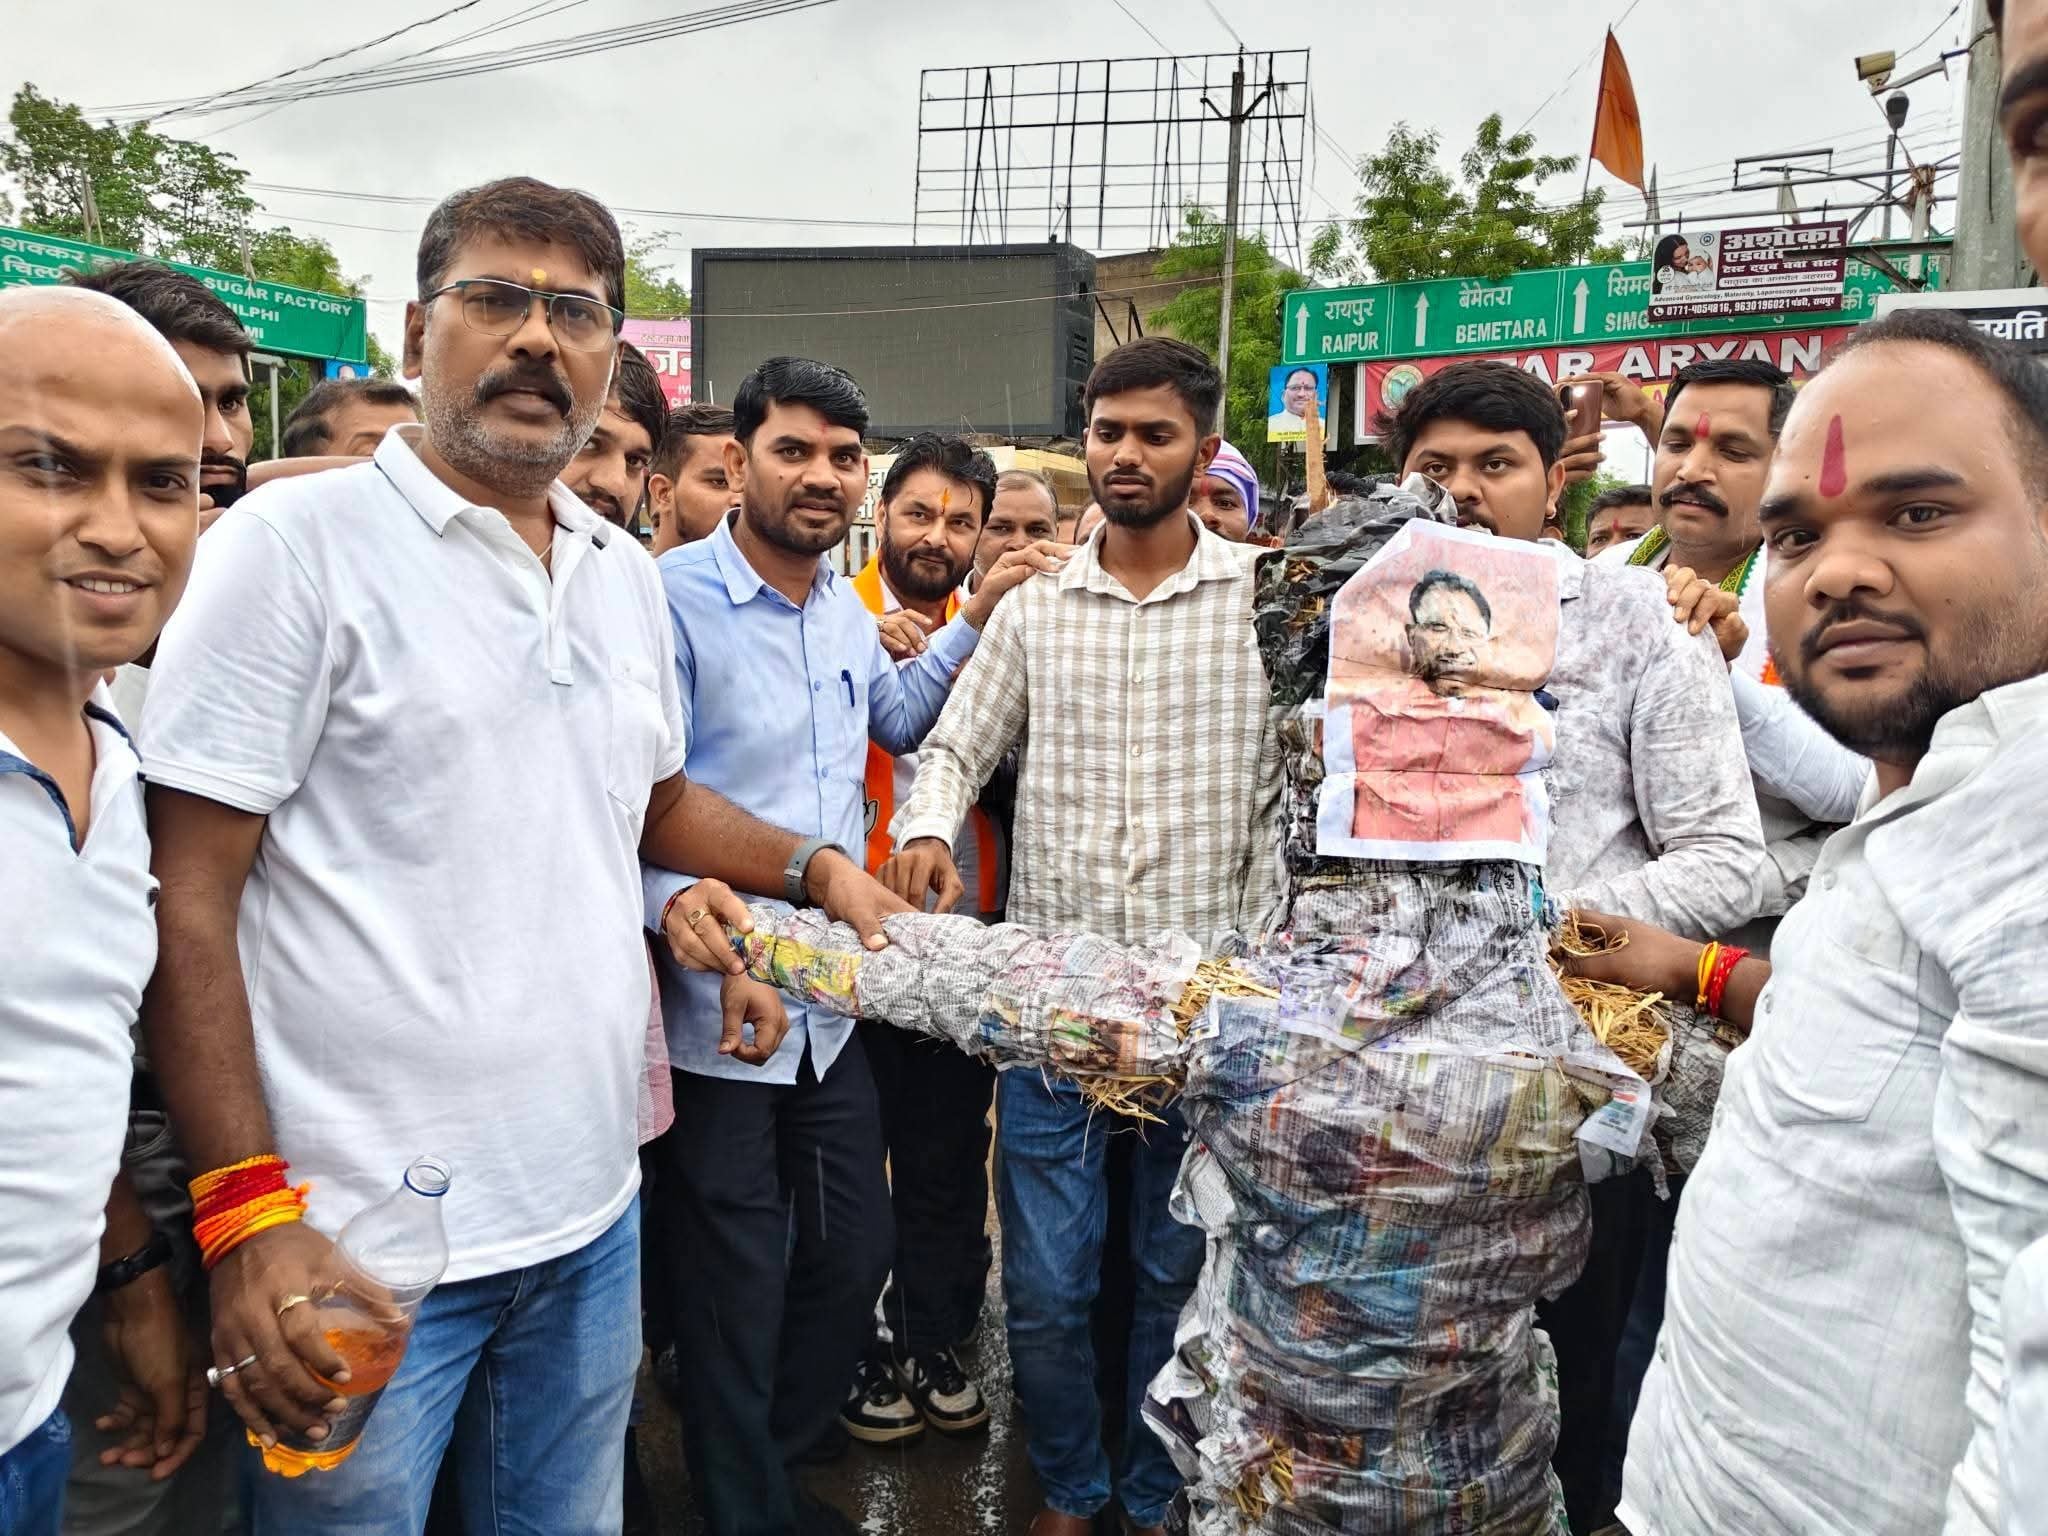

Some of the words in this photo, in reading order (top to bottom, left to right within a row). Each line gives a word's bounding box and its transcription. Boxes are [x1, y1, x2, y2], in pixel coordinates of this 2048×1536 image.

[1723, 226, 1843, 250] अशोका
[203, 277, 268, 300] SUGAR
[275, 291, 352, 316] FACTORY
[1458, 281, 1513, 309] बेमेतरा
[227, 302, 280, 322] ILPHI
[1324, 297, 1376, 327] रायपुर
[1604, 310, 1663, 333] SIMG
[1322, 331, 1379, 354] RAIPUR
[1456, 318, 1547, 344] BEMETARA
